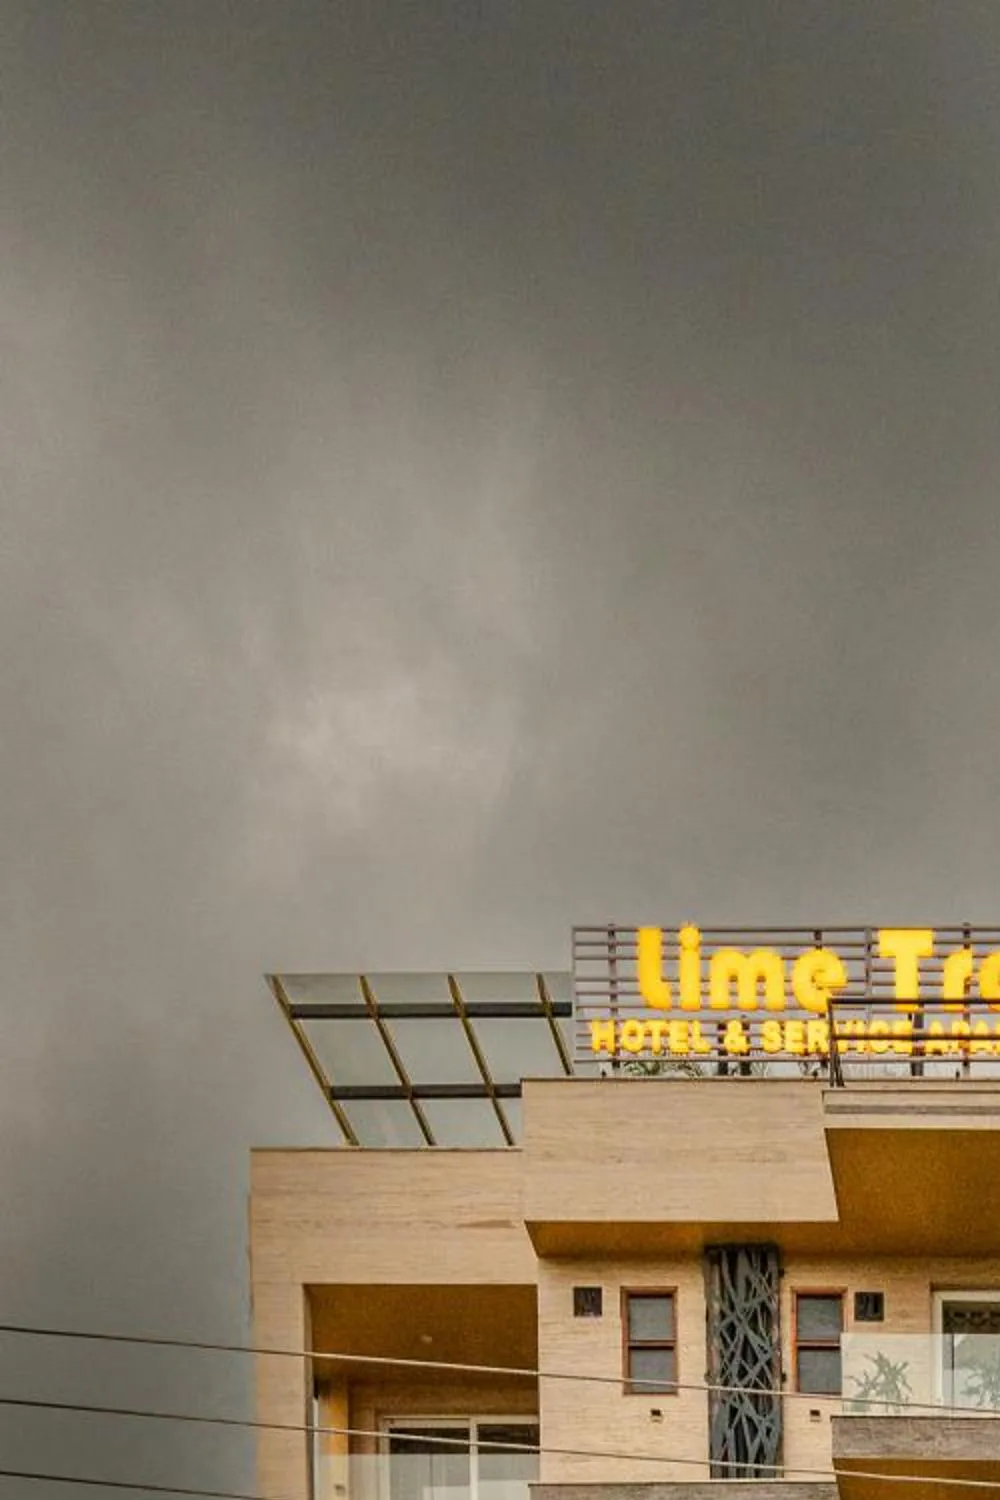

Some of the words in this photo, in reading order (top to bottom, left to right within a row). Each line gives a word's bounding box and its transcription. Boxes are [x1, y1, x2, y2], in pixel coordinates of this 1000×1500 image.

[636, 923, 848, 1011] Lime
[590, 1019, 714, 1054] HOTEL
[723, 1019, 751, 1054] &
